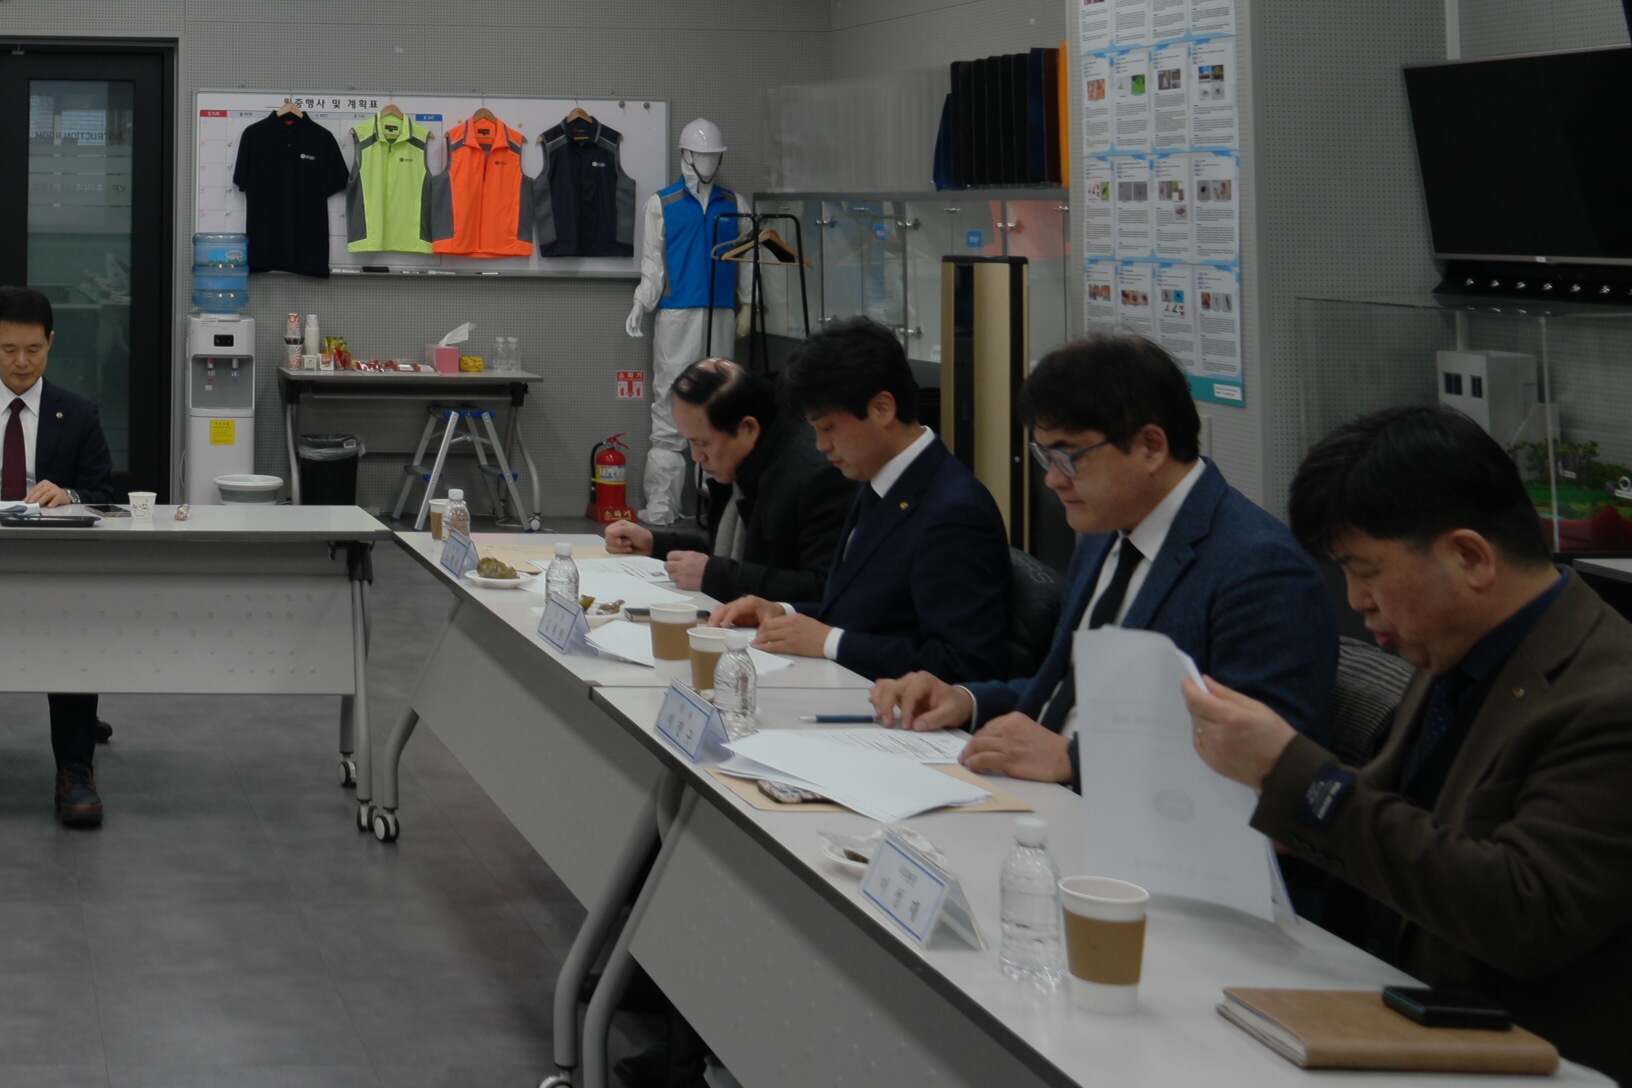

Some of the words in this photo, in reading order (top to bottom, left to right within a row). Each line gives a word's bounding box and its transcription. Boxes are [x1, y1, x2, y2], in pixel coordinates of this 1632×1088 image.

[332, 99, 341, 109] 및
[347, 99, 379, 109] 계획표
[604, 510, 631, 518] 소화기
